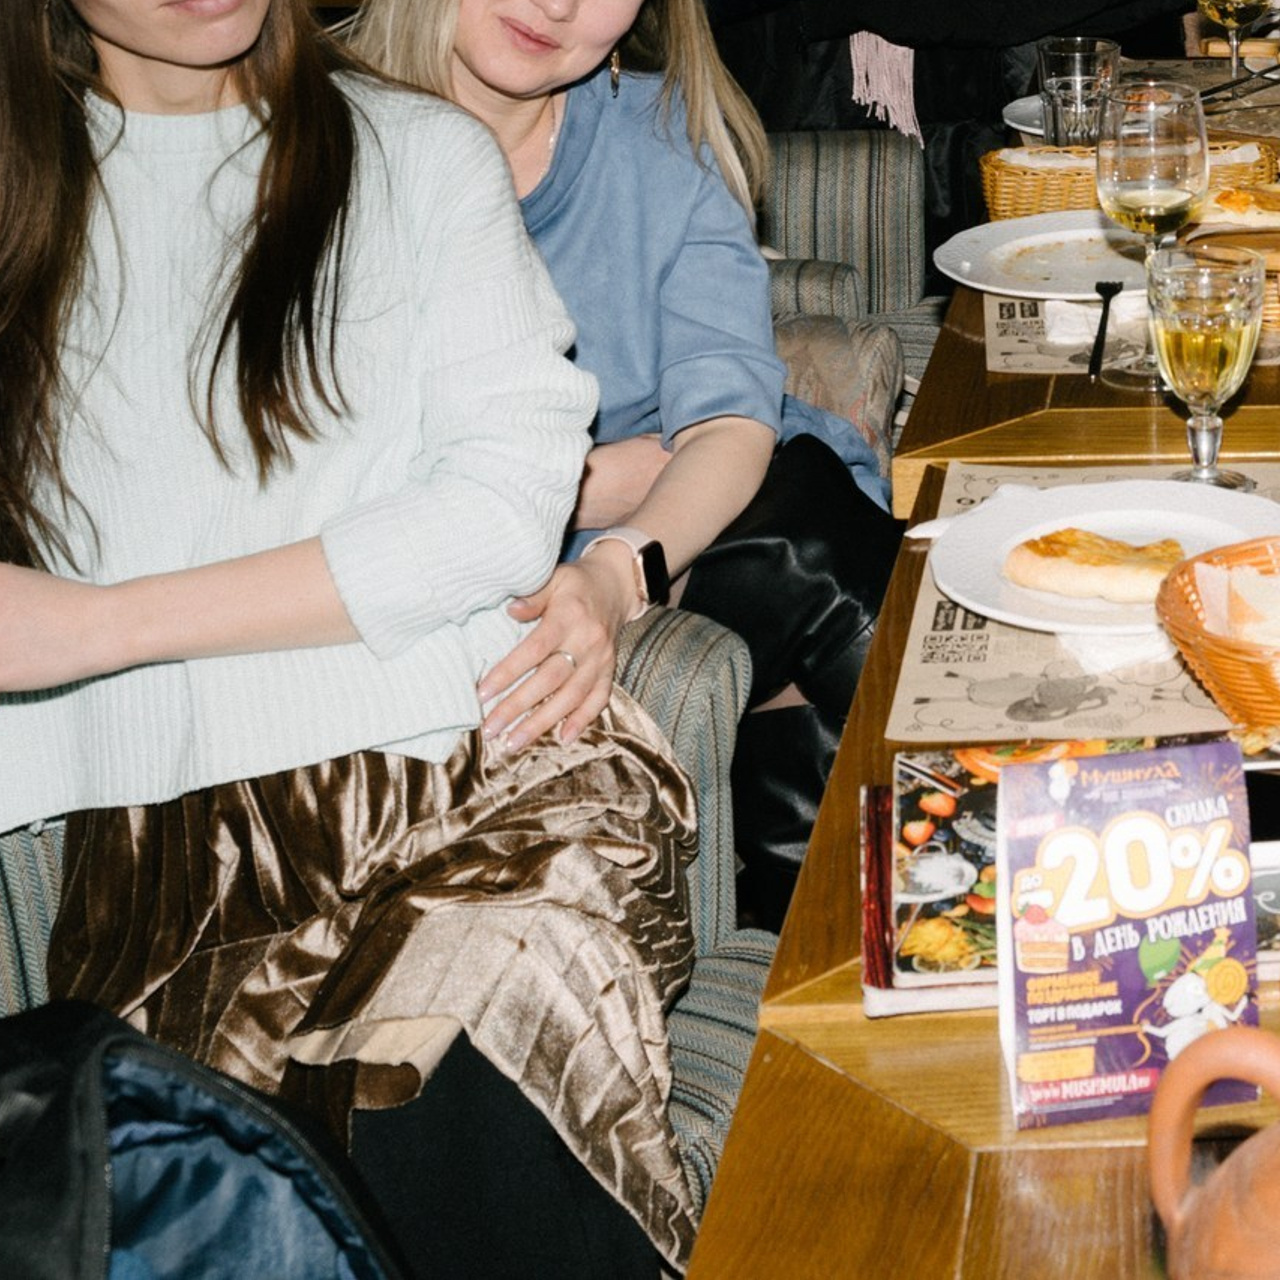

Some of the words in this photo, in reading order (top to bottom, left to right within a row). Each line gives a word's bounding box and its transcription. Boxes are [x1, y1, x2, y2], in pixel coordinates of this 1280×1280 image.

[1165, 795, 1230, 827] СКИДКА
[1072, 936, 1086, 961] В
[1093, 923, 1140, 959] ДЕНЬ
[1146, 897, 1248, 943] РОЖДЕНИЯ
[1026, 1007, 1055, 1024] ТОРТ
[1066, 999, 1123, 1019] ПОДАРОК
